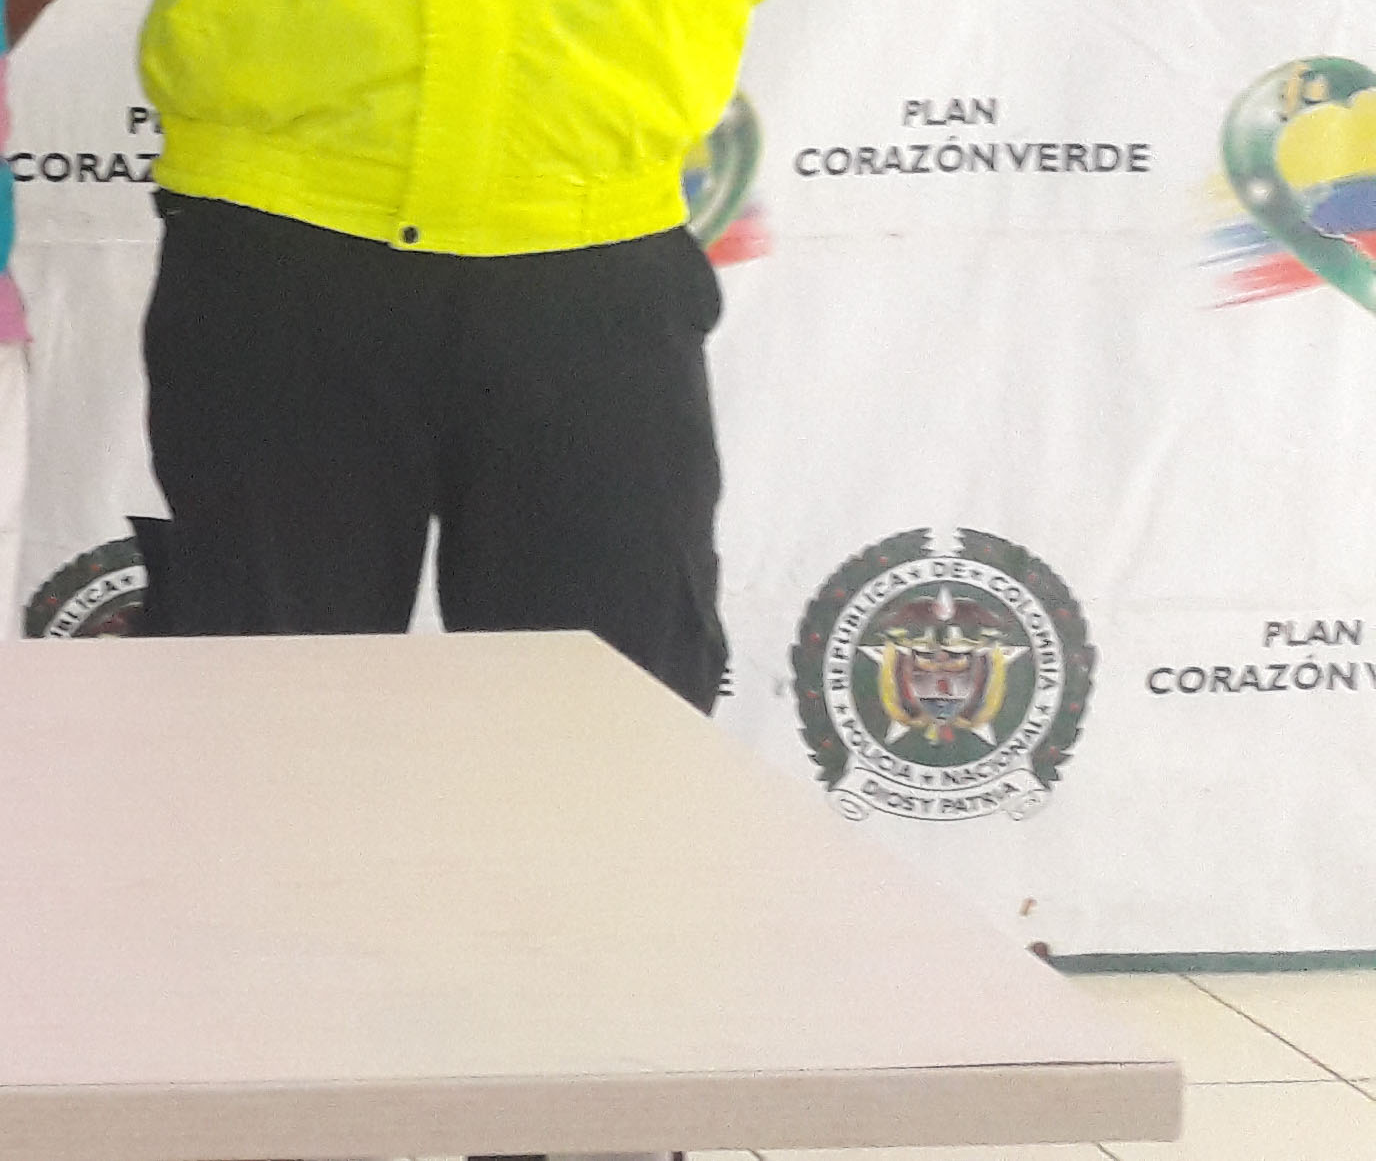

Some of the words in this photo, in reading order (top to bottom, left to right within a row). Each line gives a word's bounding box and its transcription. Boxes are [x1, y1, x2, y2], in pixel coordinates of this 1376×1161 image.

[902, 97, 998, 126] PLAN
[8, 152, 161, 183] CORAZ
[792, 135, 997, 177] CORAZÓN
[1003, 143, 1152, 173] VERDE
[931, 561, 968, 578] DE
[1262, 619, 1365, 648] PLAN
[1146, 654, 1360, 695] CORAZÓN
